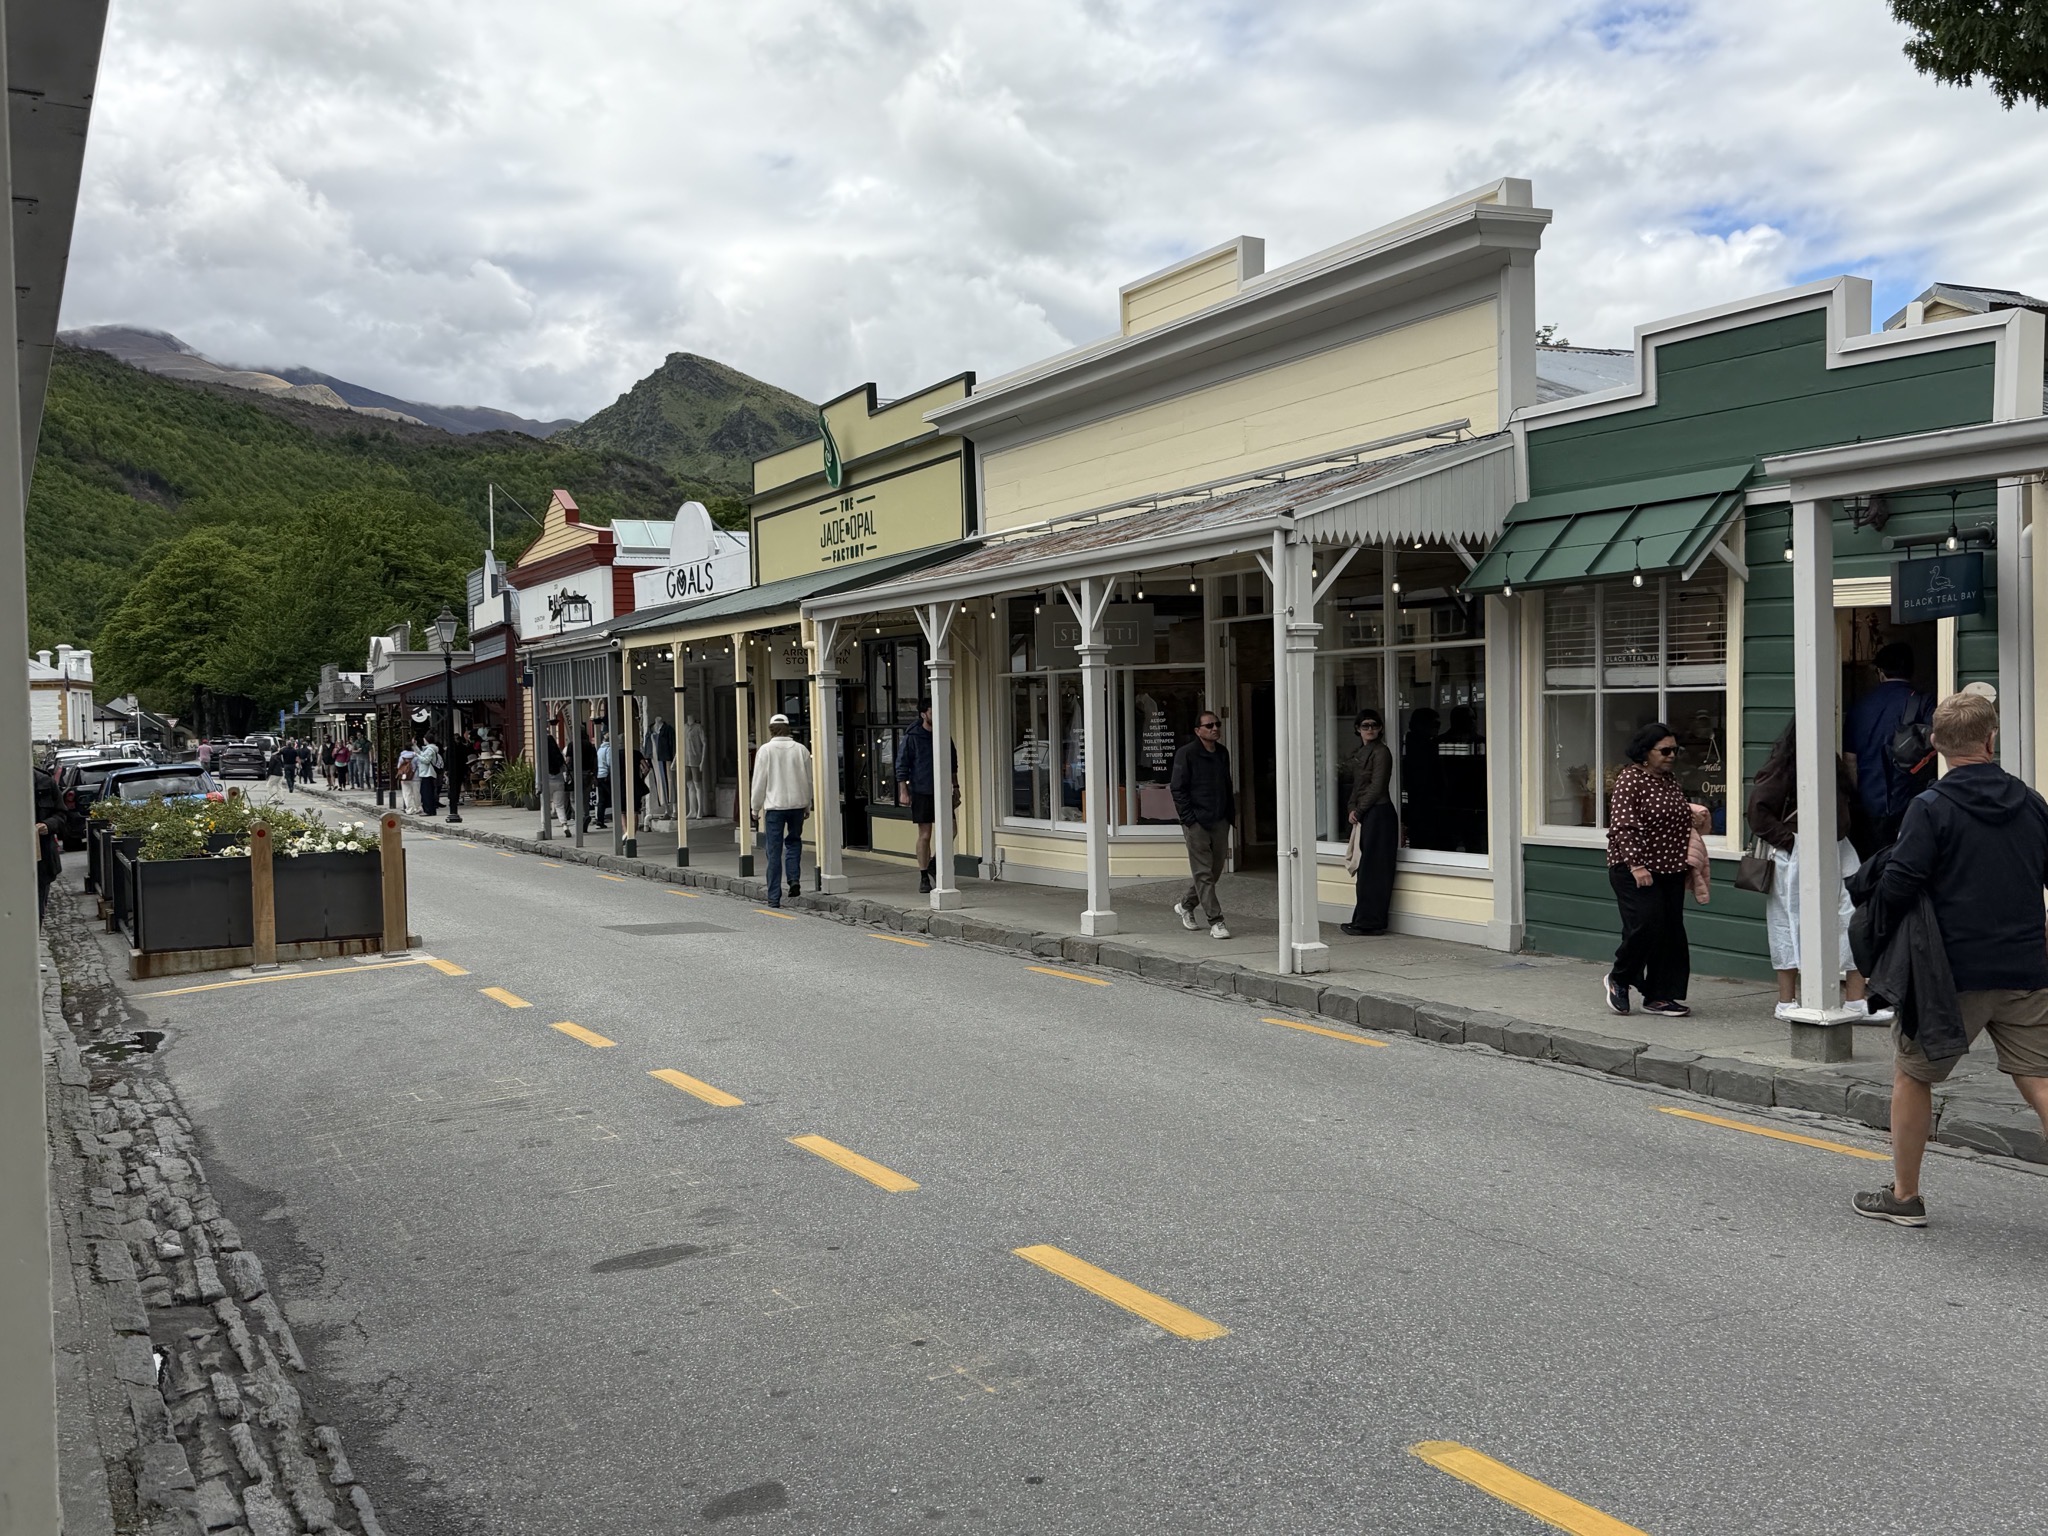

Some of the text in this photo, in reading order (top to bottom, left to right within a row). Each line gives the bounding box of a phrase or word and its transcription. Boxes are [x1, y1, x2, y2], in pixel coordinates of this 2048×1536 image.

[840, 497, 854, 513] THE
[832, 543, 864, 563] FACTORY
[666, 562, 714, 599] GOALS
[1904, 597, 1933, 608] BLACK
[1936, 593, 1958, 604] TEAL
[1961, 590, 1977, 601] BAY
[1060, 627, 1132, 641] SETTI
[1605, 655, 1627, 663] BLACK
[1701, 781, 1728, 797] Open
